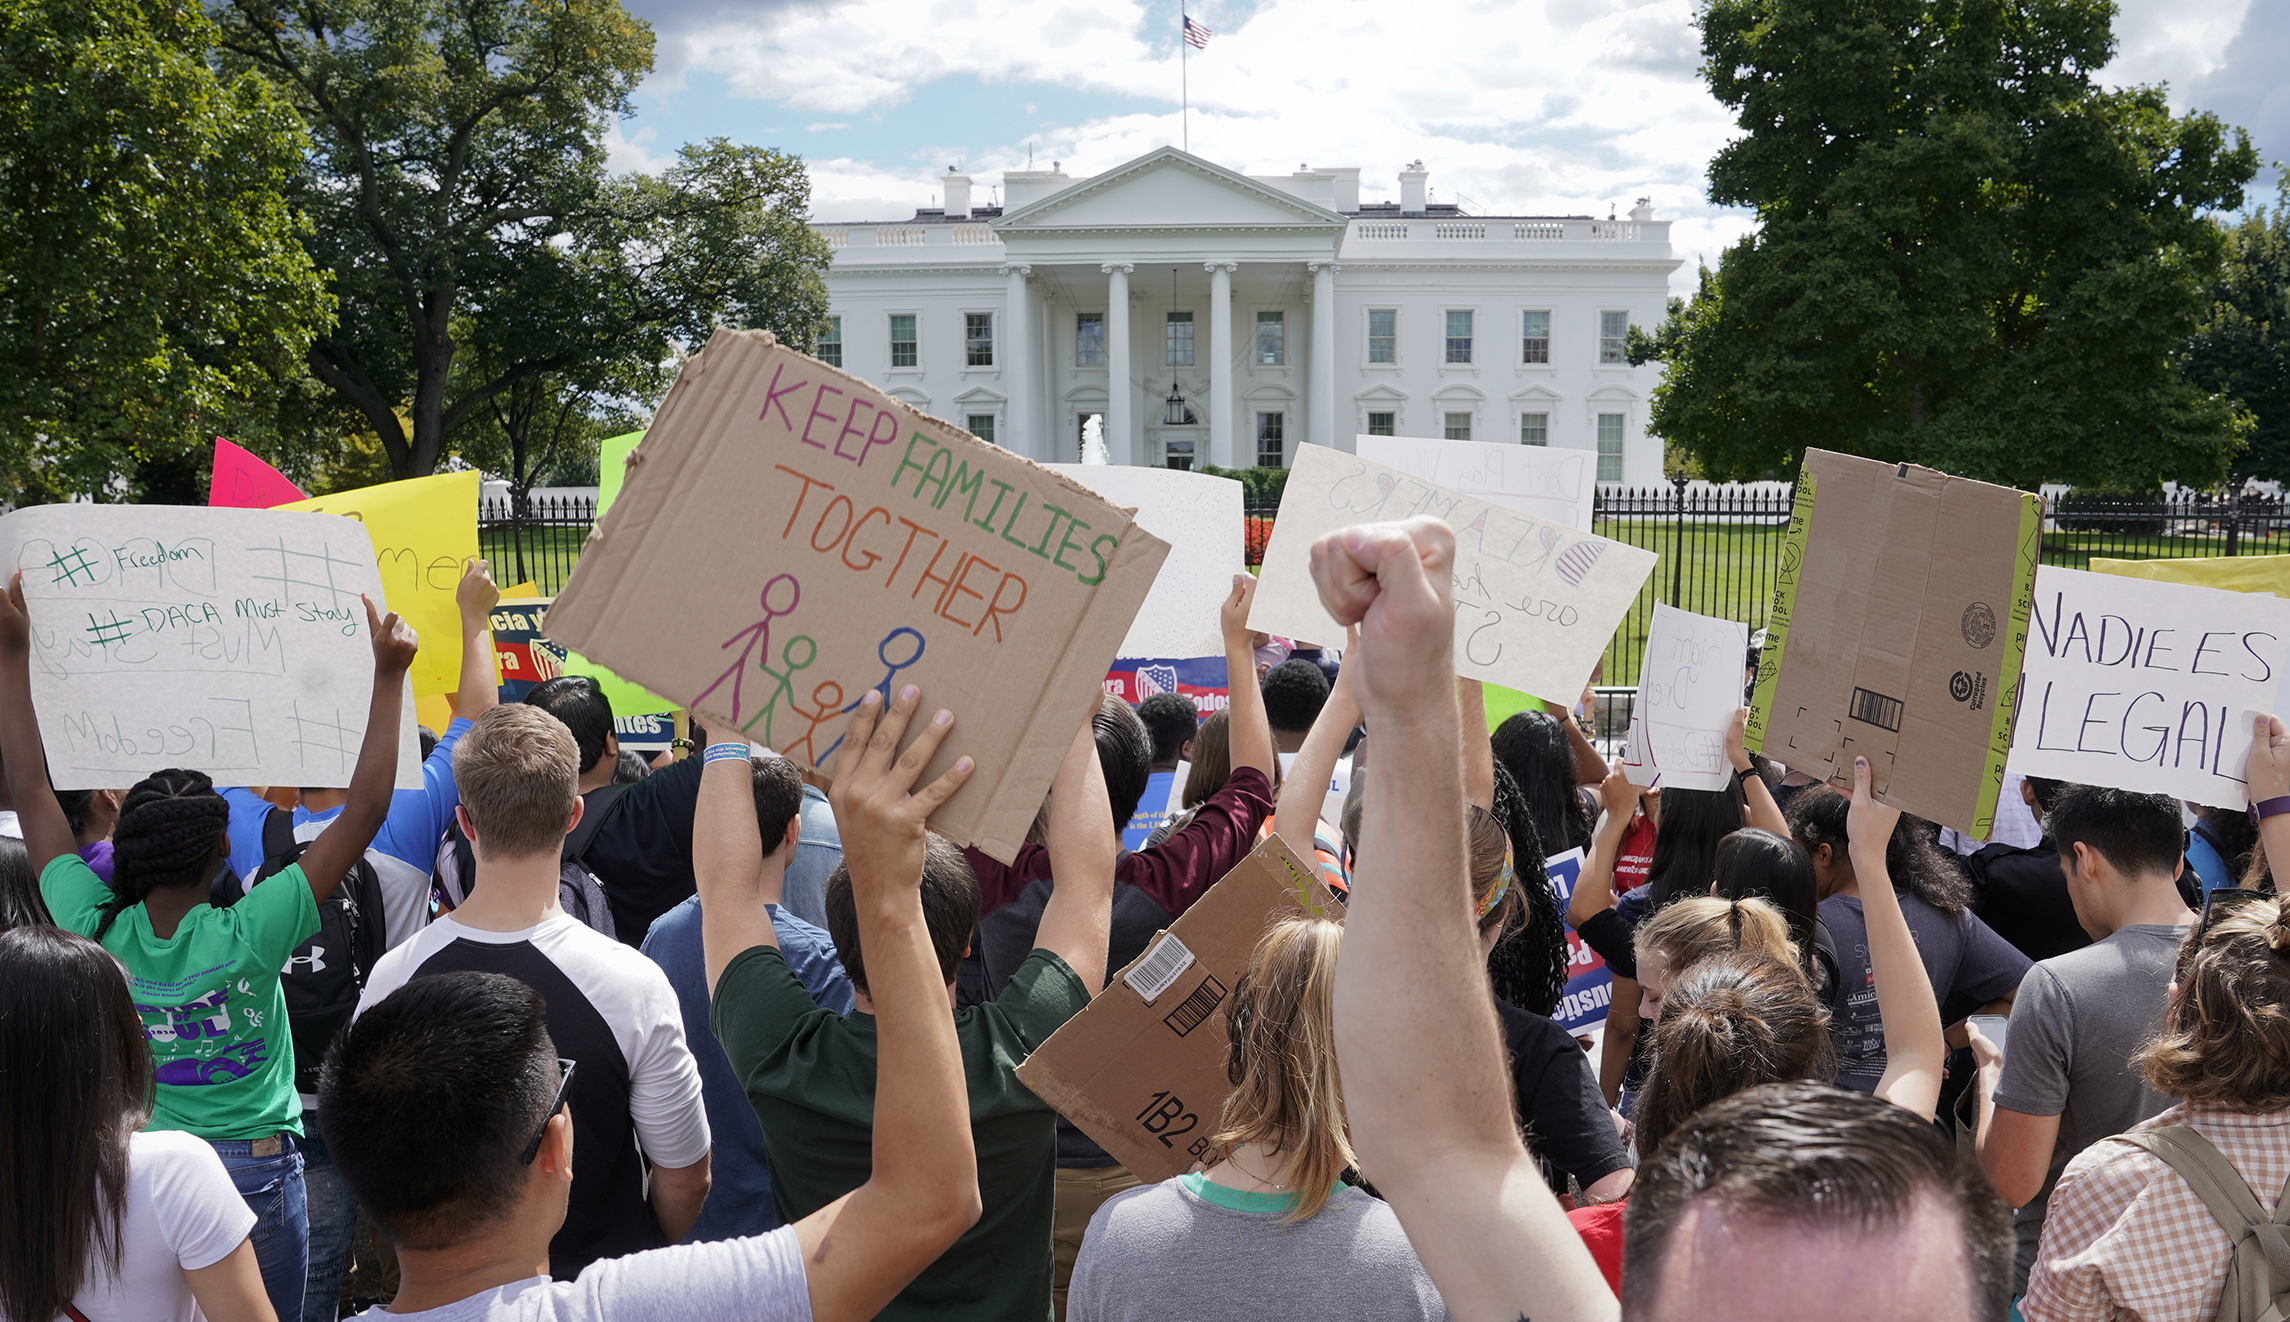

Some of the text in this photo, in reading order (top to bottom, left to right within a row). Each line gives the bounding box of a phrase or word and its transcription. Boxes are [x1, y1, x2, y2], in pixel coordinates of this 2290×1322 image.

[759, 363, 1118, 586] KEEP FAMILIES
[1800, 471, 1809, 479] CK
[1797, 486, 1812, 496] OOL
[1791, 516, 1804, 526] me
[113, 541, 204, 572] Freedom
[775, 464, 1028, 643] TOGTHER
[1772, 605, 1788, 615] OOL
[1775, 590, 1785, 599] CK
[141, 602, 223, 633] DACA
[296, 602, 359, 637] Stay
[489, 611, 530, 632] cia
[1765, 633, 1780, 643] me
[2033, 591, 2179, 671] NADIE
[2191, 631, 2278, 683] ES
[496, 651, 520, 670] ra
[1969, 671, 1982, 711] Corrugated
[1975, 677, 1988, 710] Recycles
[1748, 719, 1762, 730] OOL
[1750, 705, 1760, 714] CK
[2010, 672, 2248, 785] ILEGAL
[1551, 981, 1612, 1021] ustic
[1135, 1090, 1199, 1149] 1B2
[1187, 1136, 1222, 1167] BO
